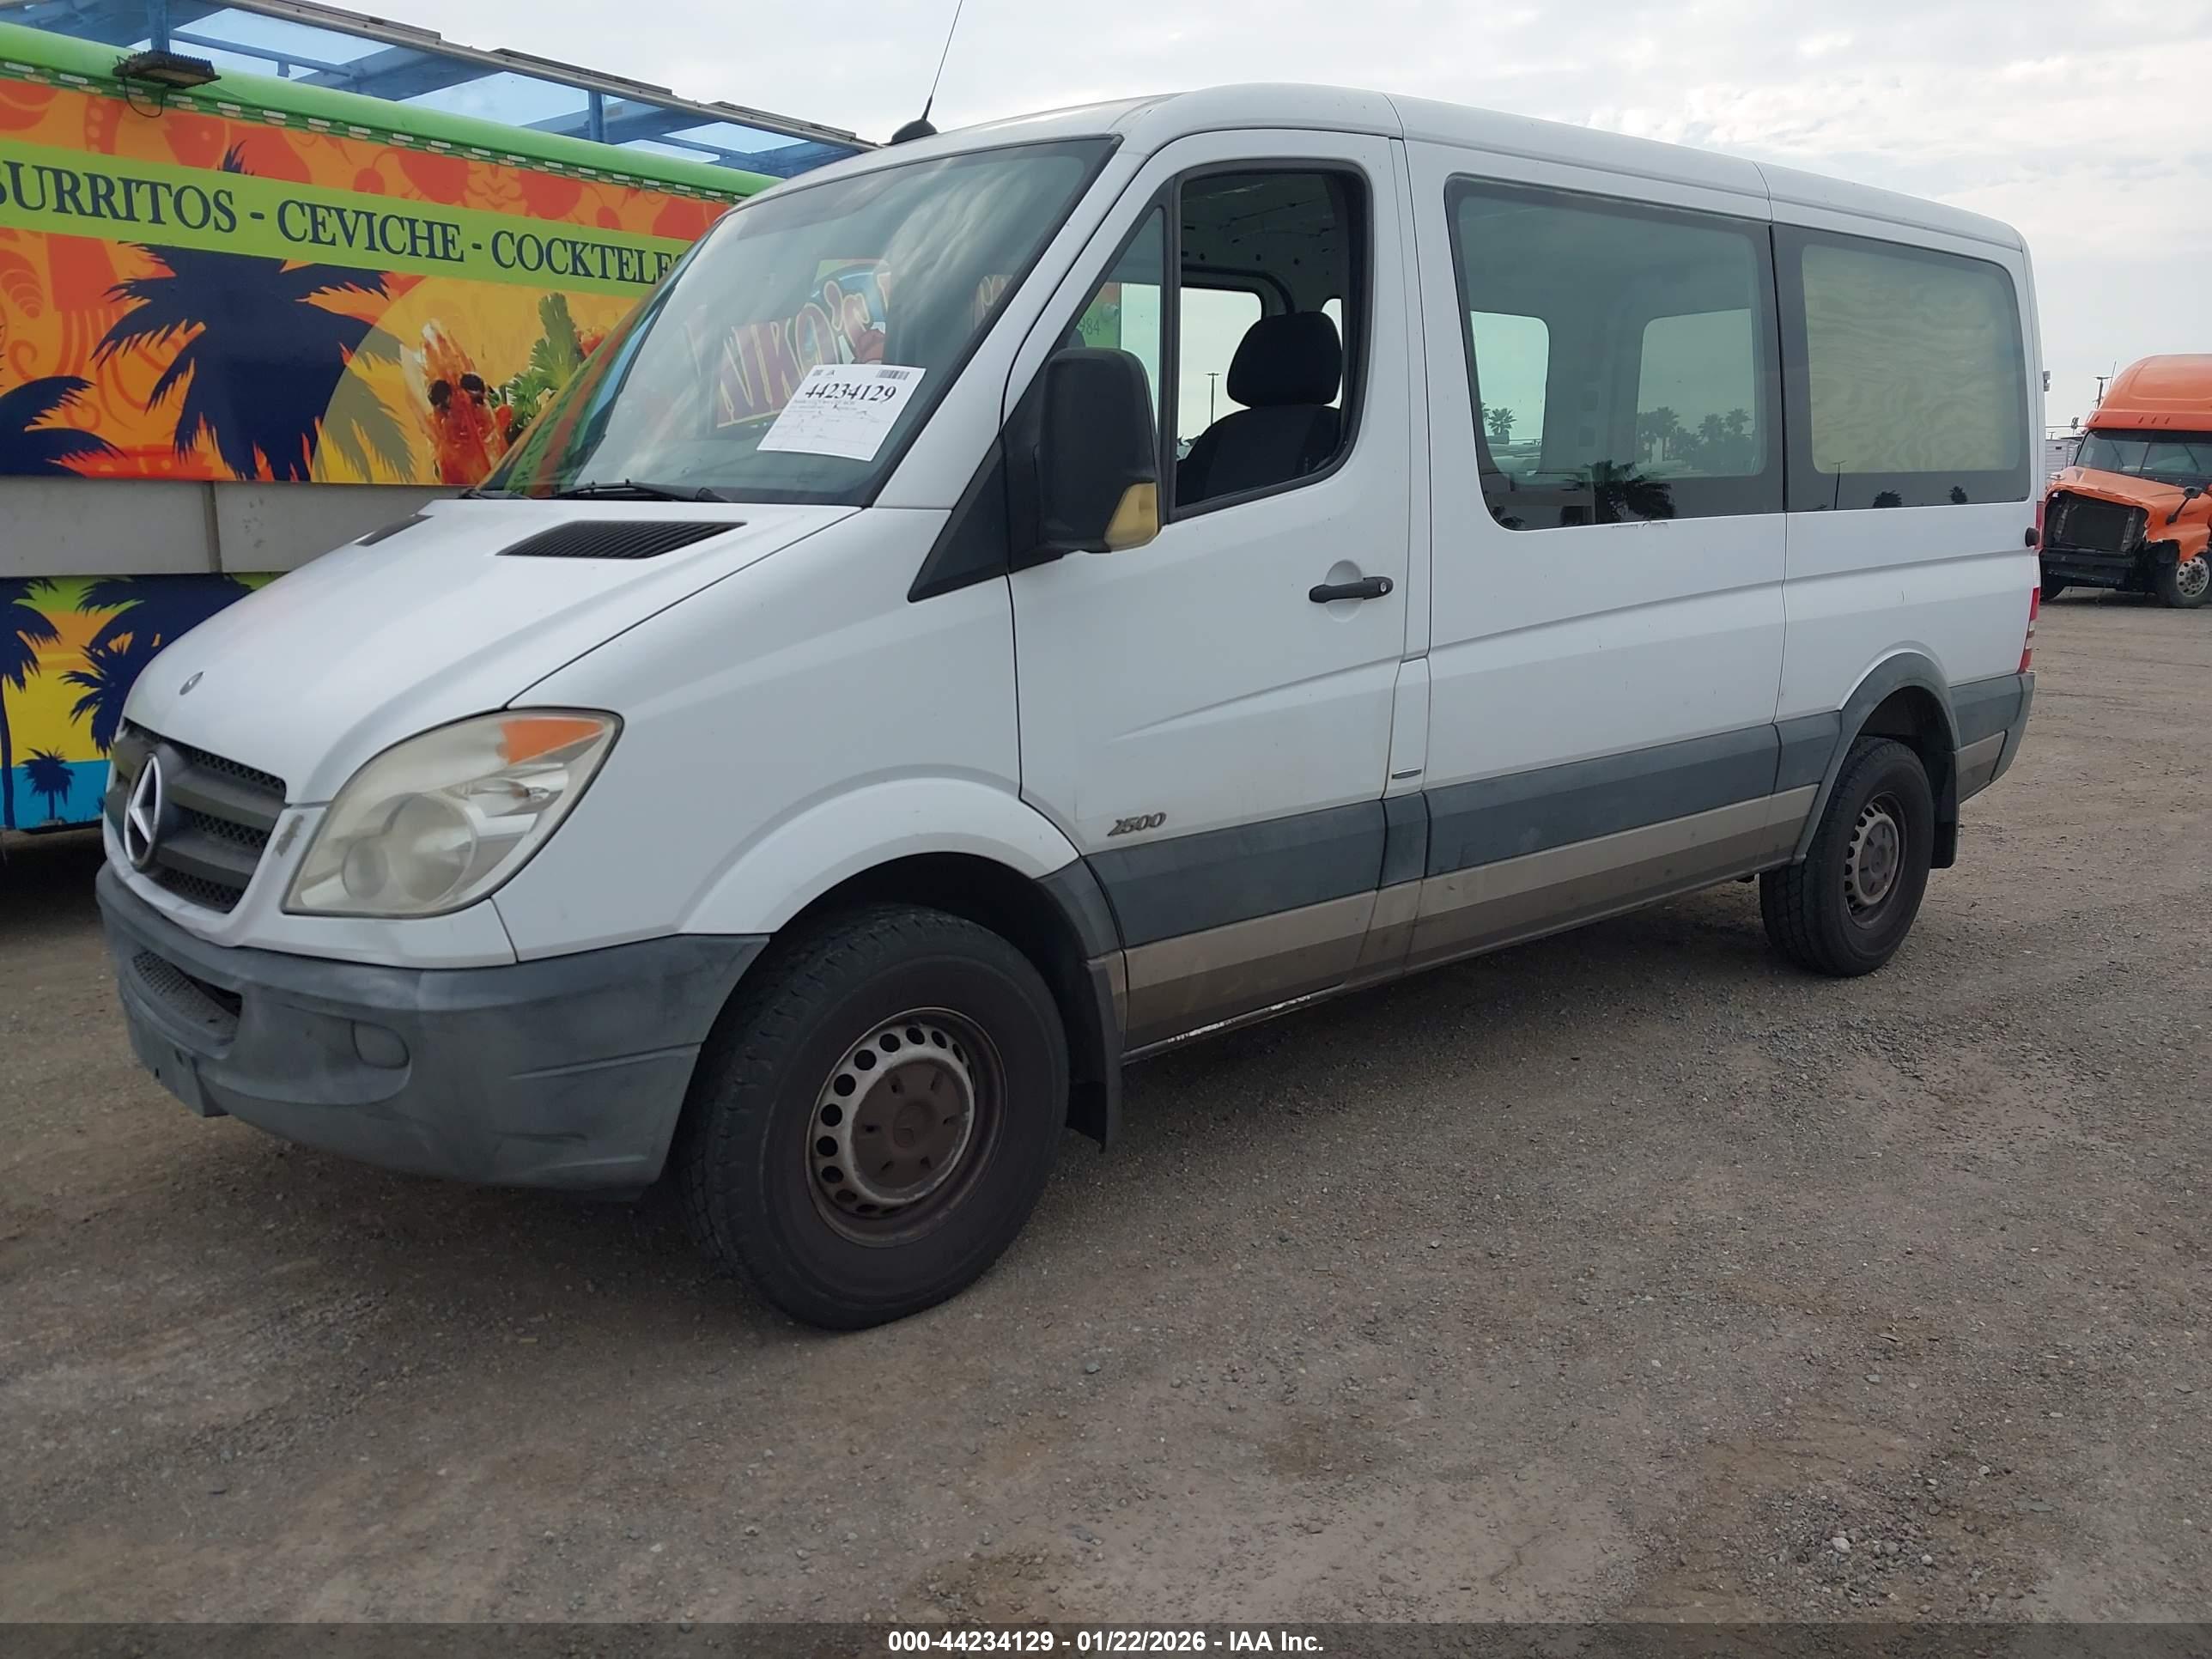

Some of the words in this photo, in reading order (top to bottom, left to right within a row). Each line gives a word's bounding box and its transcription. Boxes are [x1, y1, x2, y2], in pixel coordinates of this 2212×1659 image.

[0, 160, 237, 234] URRITOS
[277, 199, 465, 262] CEVICHE
[805, 382, 896, 403] 44234129
[1107, 811, 1167, 836] 2500
